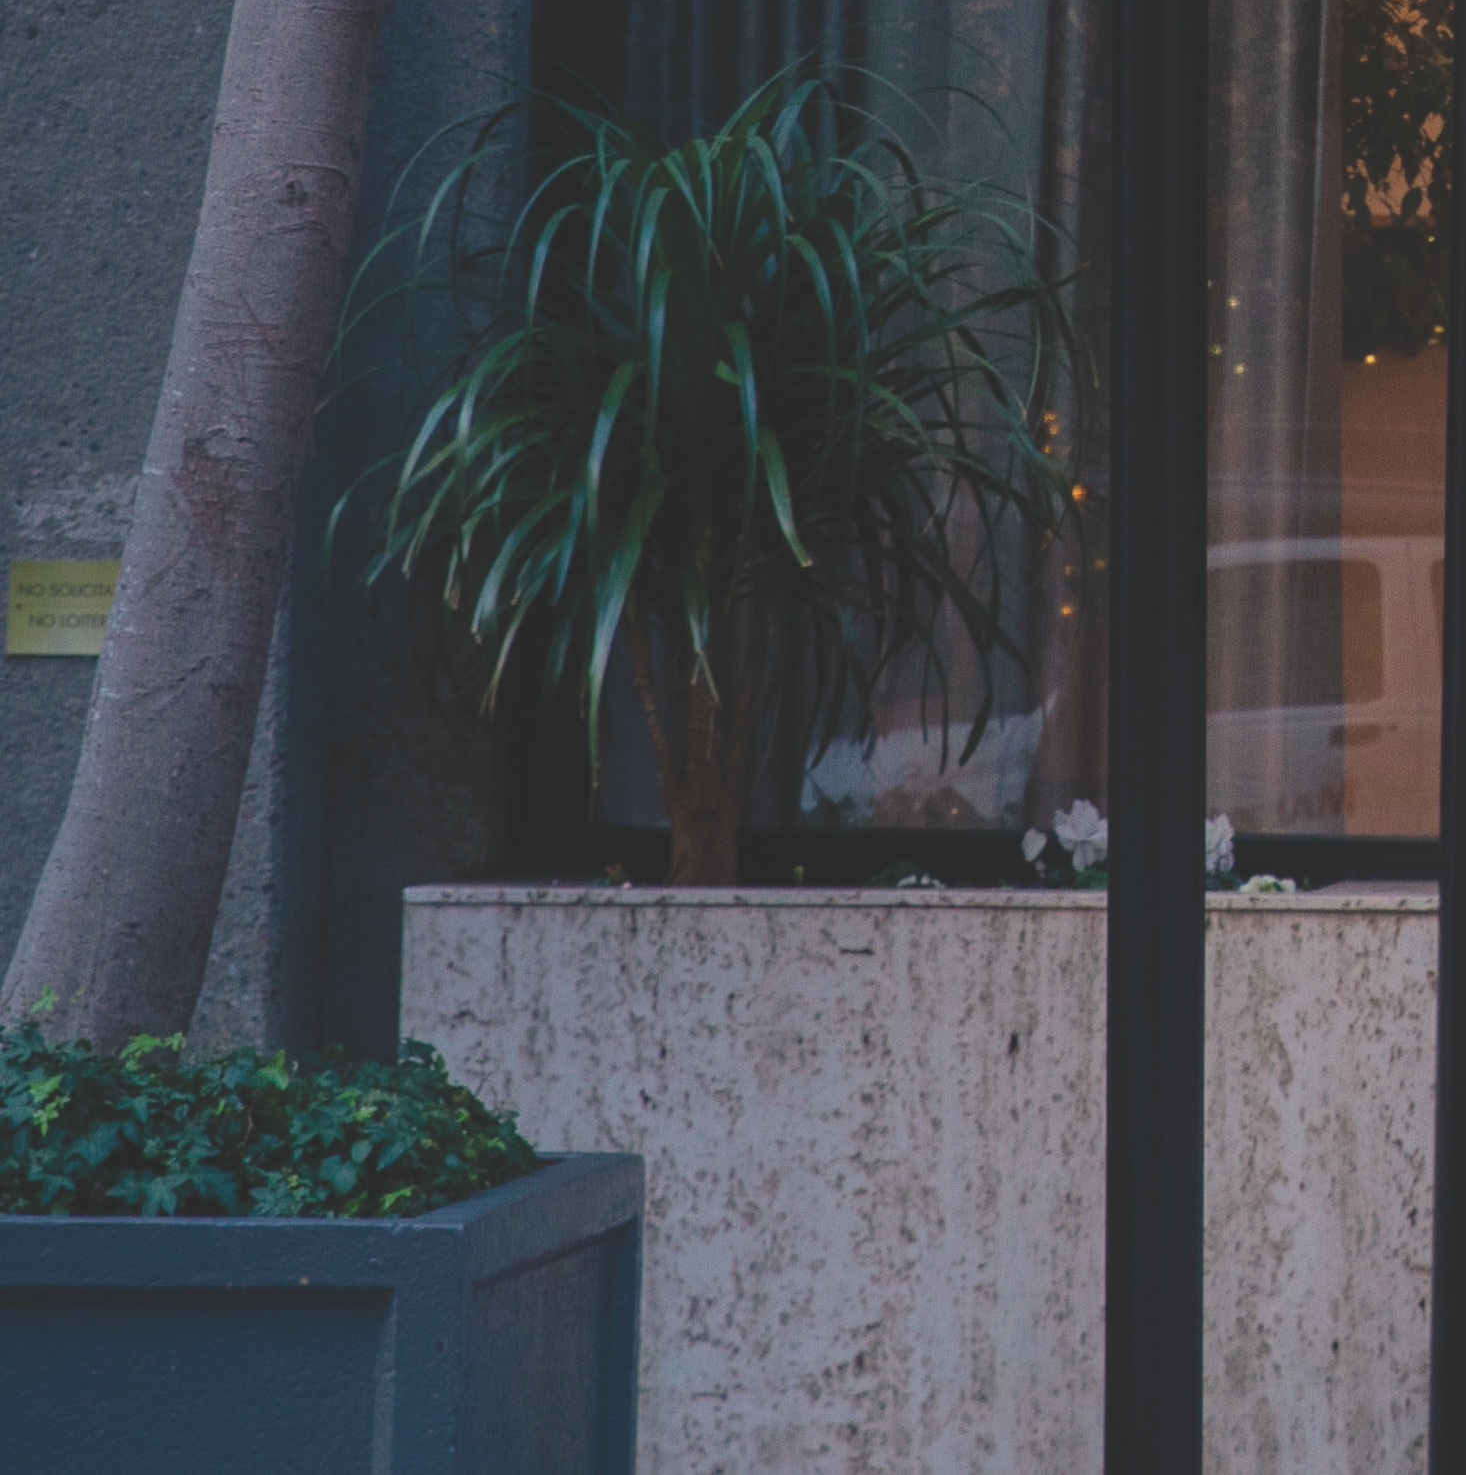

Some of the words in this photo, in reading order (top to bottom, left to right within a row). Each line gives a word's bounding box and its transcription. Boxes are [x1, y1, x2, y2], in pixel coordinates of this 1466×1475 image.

[18, 583, 45, 596] NO
[49, 583, 116, 597] SOLICITA
[28, 613, 56, 627] NO
